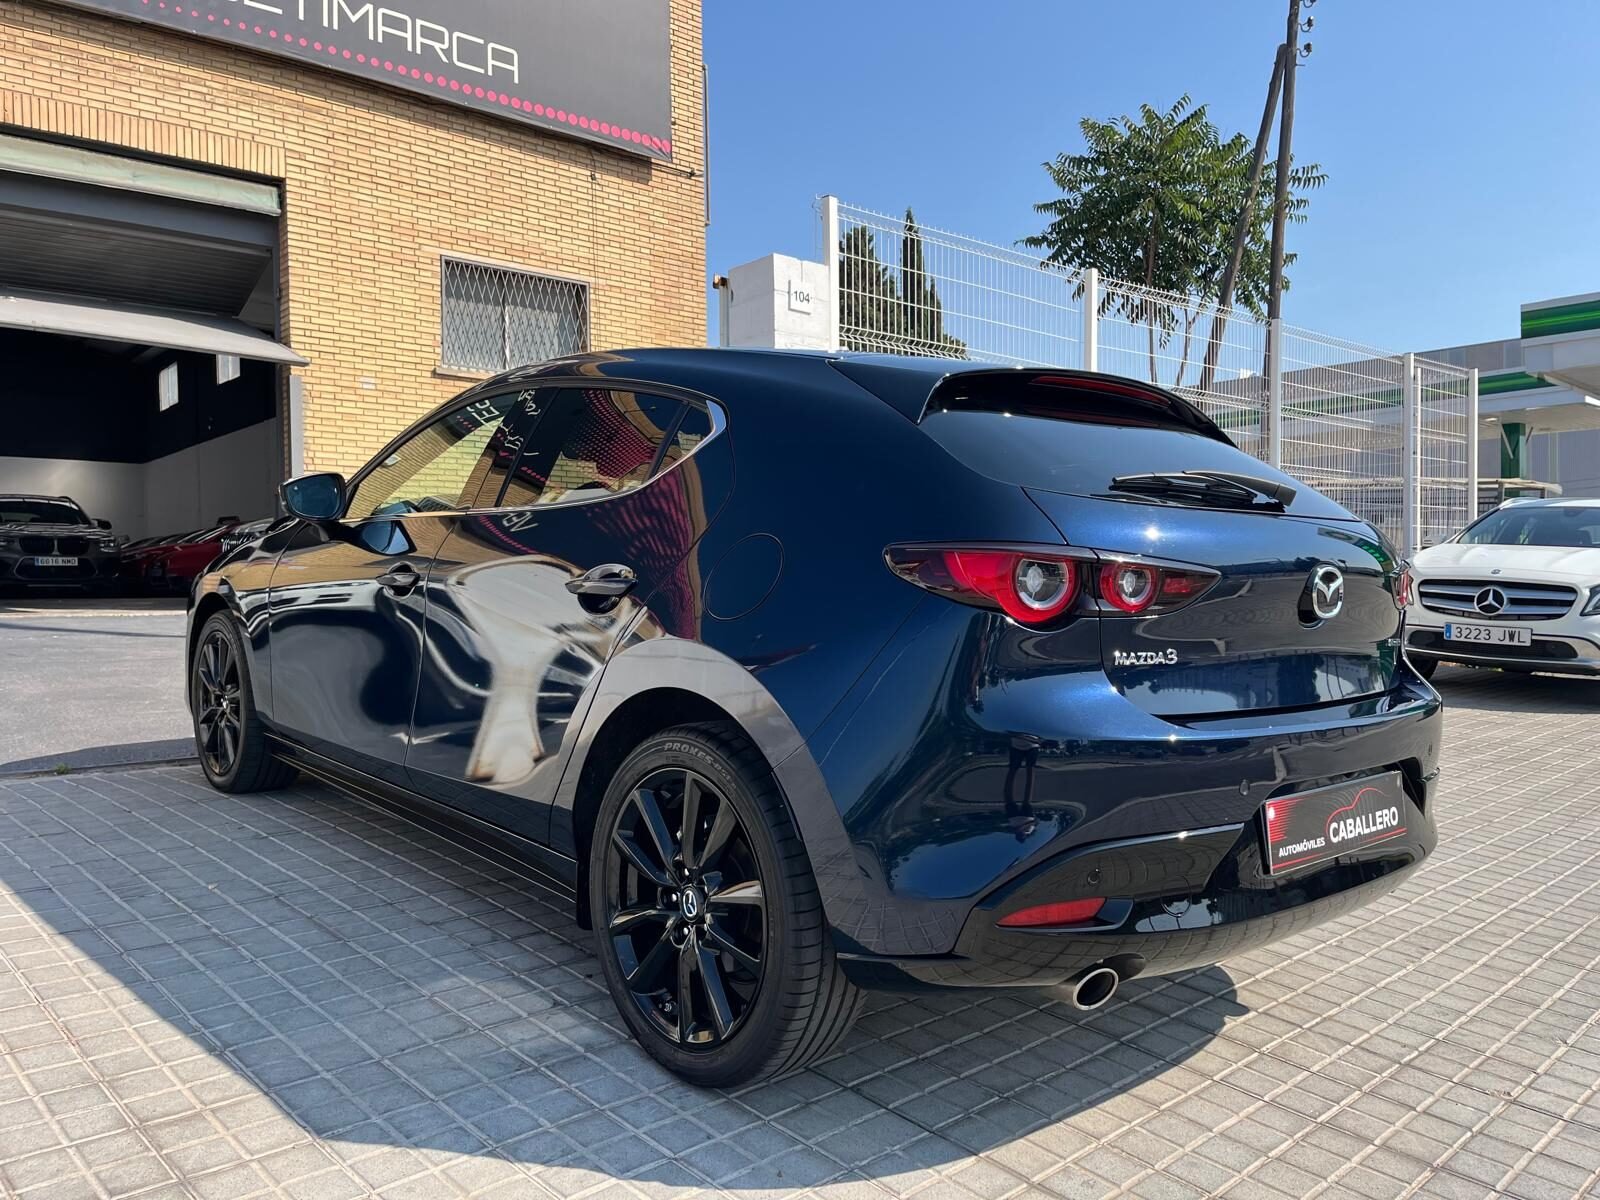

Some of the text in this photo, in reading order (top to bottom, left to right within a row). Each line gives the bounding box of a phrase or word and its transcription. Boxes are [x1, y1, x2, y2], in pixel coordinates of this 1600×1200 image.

[793, 290, 810, 304] 104
[1455, 626, 1527, 643] 3223 JWL
[1114, 648, 1178, 665] MAZDA3
[1278, 806, 1399, 858] AUTOMÓVILES CABALLERO
